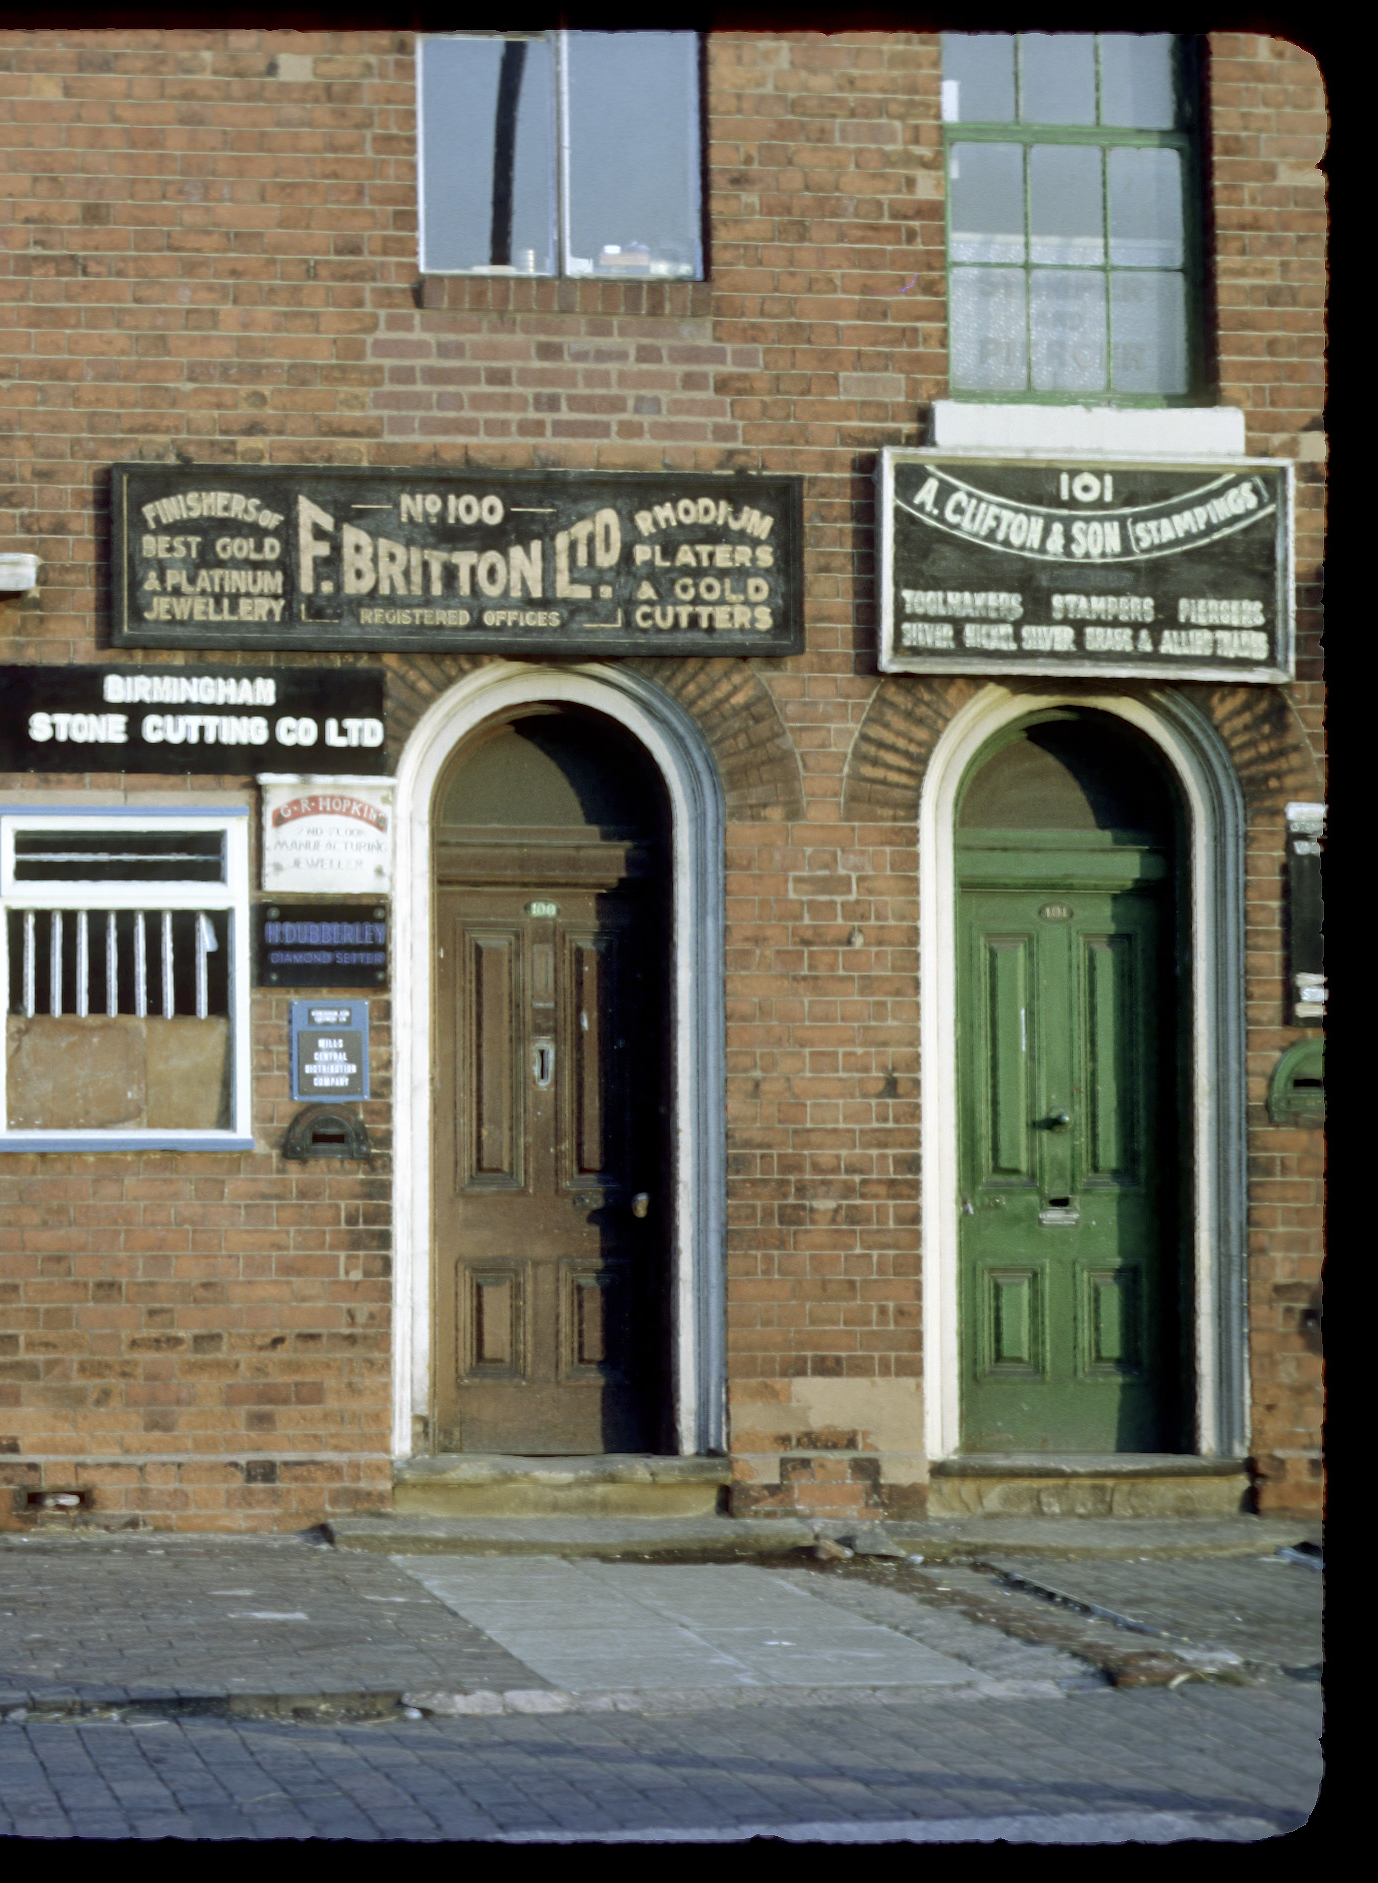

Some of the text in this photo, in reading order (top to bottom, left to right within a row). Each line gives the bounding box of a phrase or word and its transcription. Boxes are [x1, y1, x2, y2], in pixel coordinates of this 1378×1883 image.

[1059, 471, 1113, 502] 101
[141, 491, 284, 530] FINISHERS OF
[447, 494, 504, 526] 100
[634, 497, 775, 540] RHODIUM
[912, 476, 940, 515] A.
[943, 490, 1045, 550] CLIFTON
[1045, 521, 1066, 558] &
[1070, 519, 1121, 559] SON
[142, 534, 281, 560] BEST GOLD
[297, 494, 335, 594] F.
[342, 522, 543, 598] BRITTON
[633, 544, 774, 568] PLATERS
[143, 568, 284, 595] & PLATINUM
[673, 576, 770, 603] GOLD
[143, 596, 285, 622] JEWELLERY
[360, 607, 562, 628] REGISTERED OFFICES
[635, 603, 774, 632] CUTTERS
[901, 589, 1267, 628] TOOLMAKERS STAMPERS PIERCERS
[103, 674, 277, 706] BIRMINGHAM
[28, 711, 385, 748] STONE CUTTING CO LTD
[530, 901, 557, 918] 100
[270, 951, 386, 965] DIAMOND SETTER
[313, 1077, 349, 1087] COMPANY
